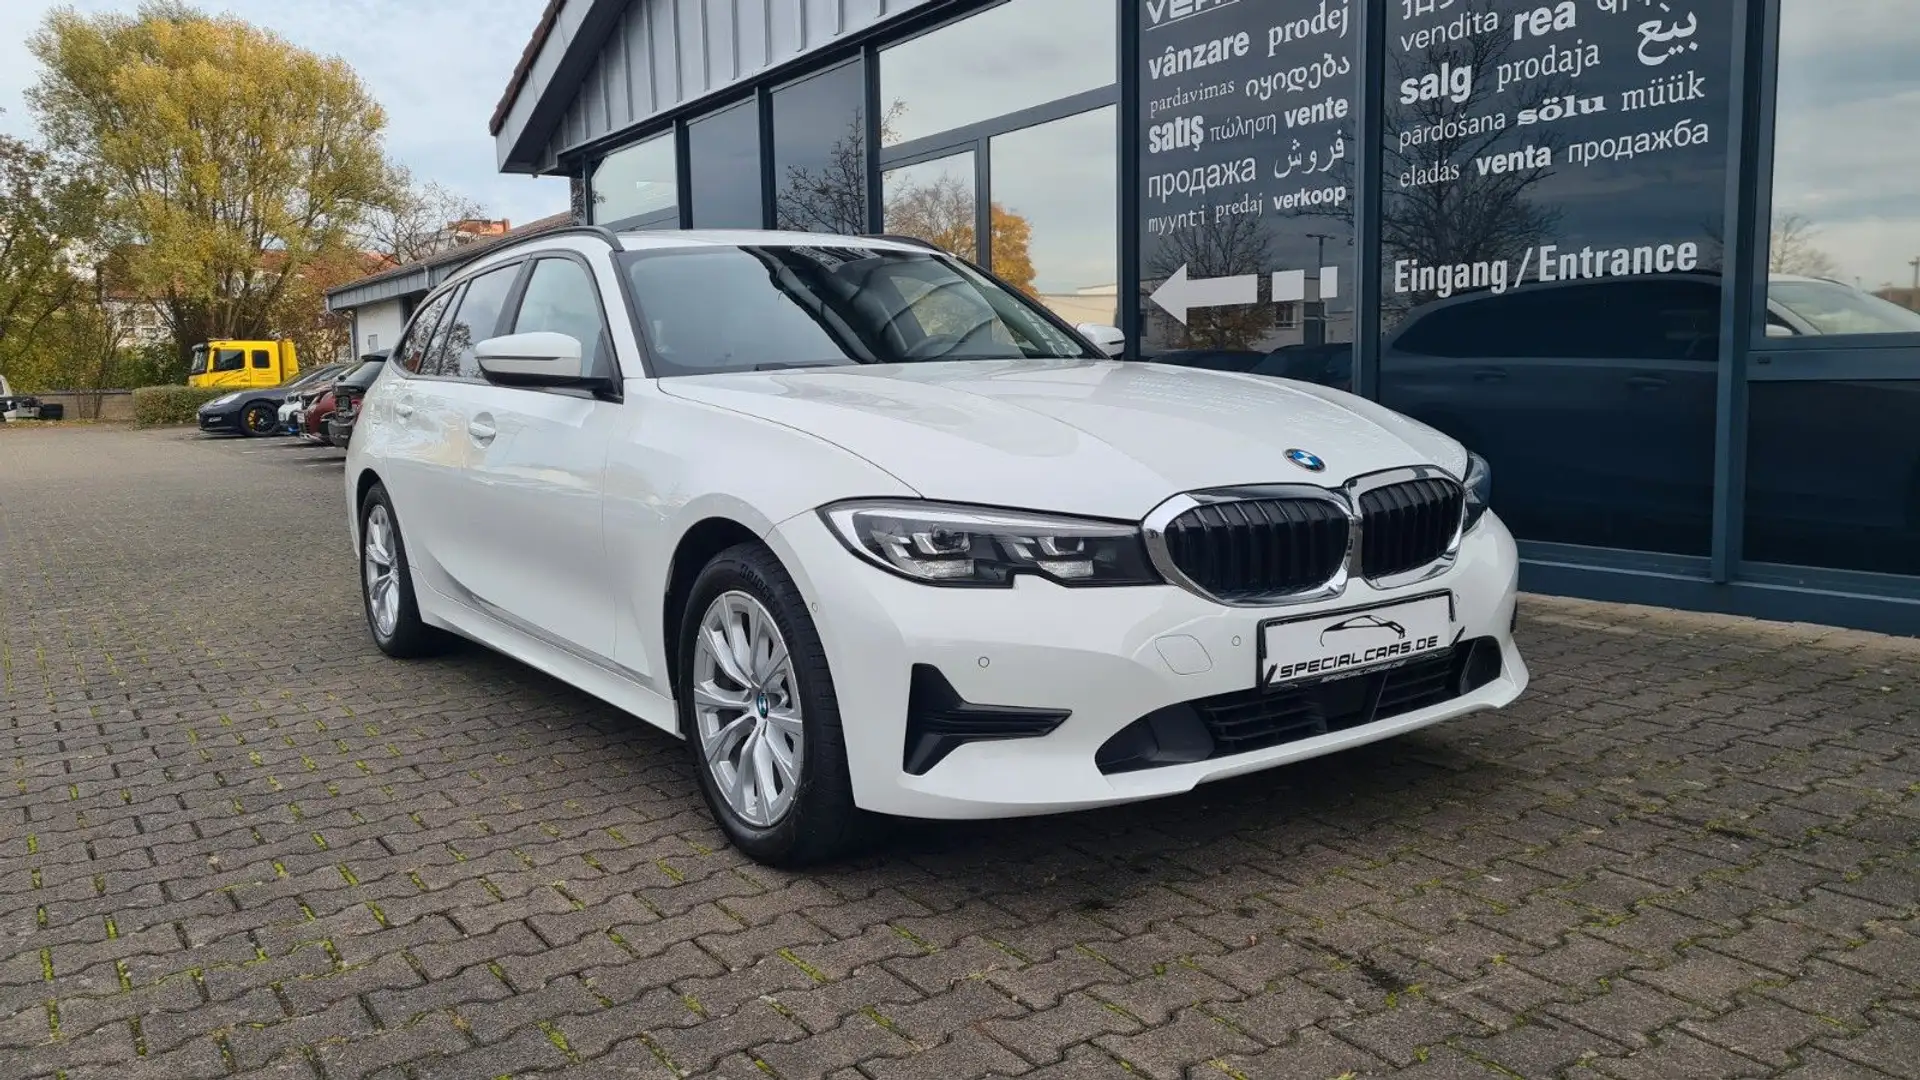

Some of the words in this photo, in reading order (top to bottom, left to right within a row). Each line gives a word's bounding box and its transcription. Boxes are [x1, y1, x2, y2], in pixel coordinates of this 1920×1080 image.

[1148, 31, 1251, 80] vânzare
[1267, 0, 1350, 57] prodej
[1401, 11, 1499, 51] vendita
[1513, 1, 1577, 40] rea
[1400, 62, 1472, 104] salg
[1496, 38, 1600, 93] prodaja
[1149, 80, 1235, 118] pardavimas
[1284, 96, 1349, 128] vente
[1400, 113, 1506, 153] pārdošana
[1517, 95, 1607, 126] sölu
[1621, 70, 1706, 111] müük
[1149, 115, 1204, 154] satış
[1210, 113, 1277, 142] πώληση
[1568, 118, 1709, 168] продажба
[1148, 157, 1256, 203] продажа
[1400, 159, 1460, 188] eladás
[1476, 144, 1552, 176] venta
[1148, 205, 1206, 235] myynti
[1215, 192, 1263, 223] predaj
[1273, 185, 1346, 210] verkoop
[1394, 258, 1508, 298] Eingang
[1538, 241, 1698, 282] Entrance
